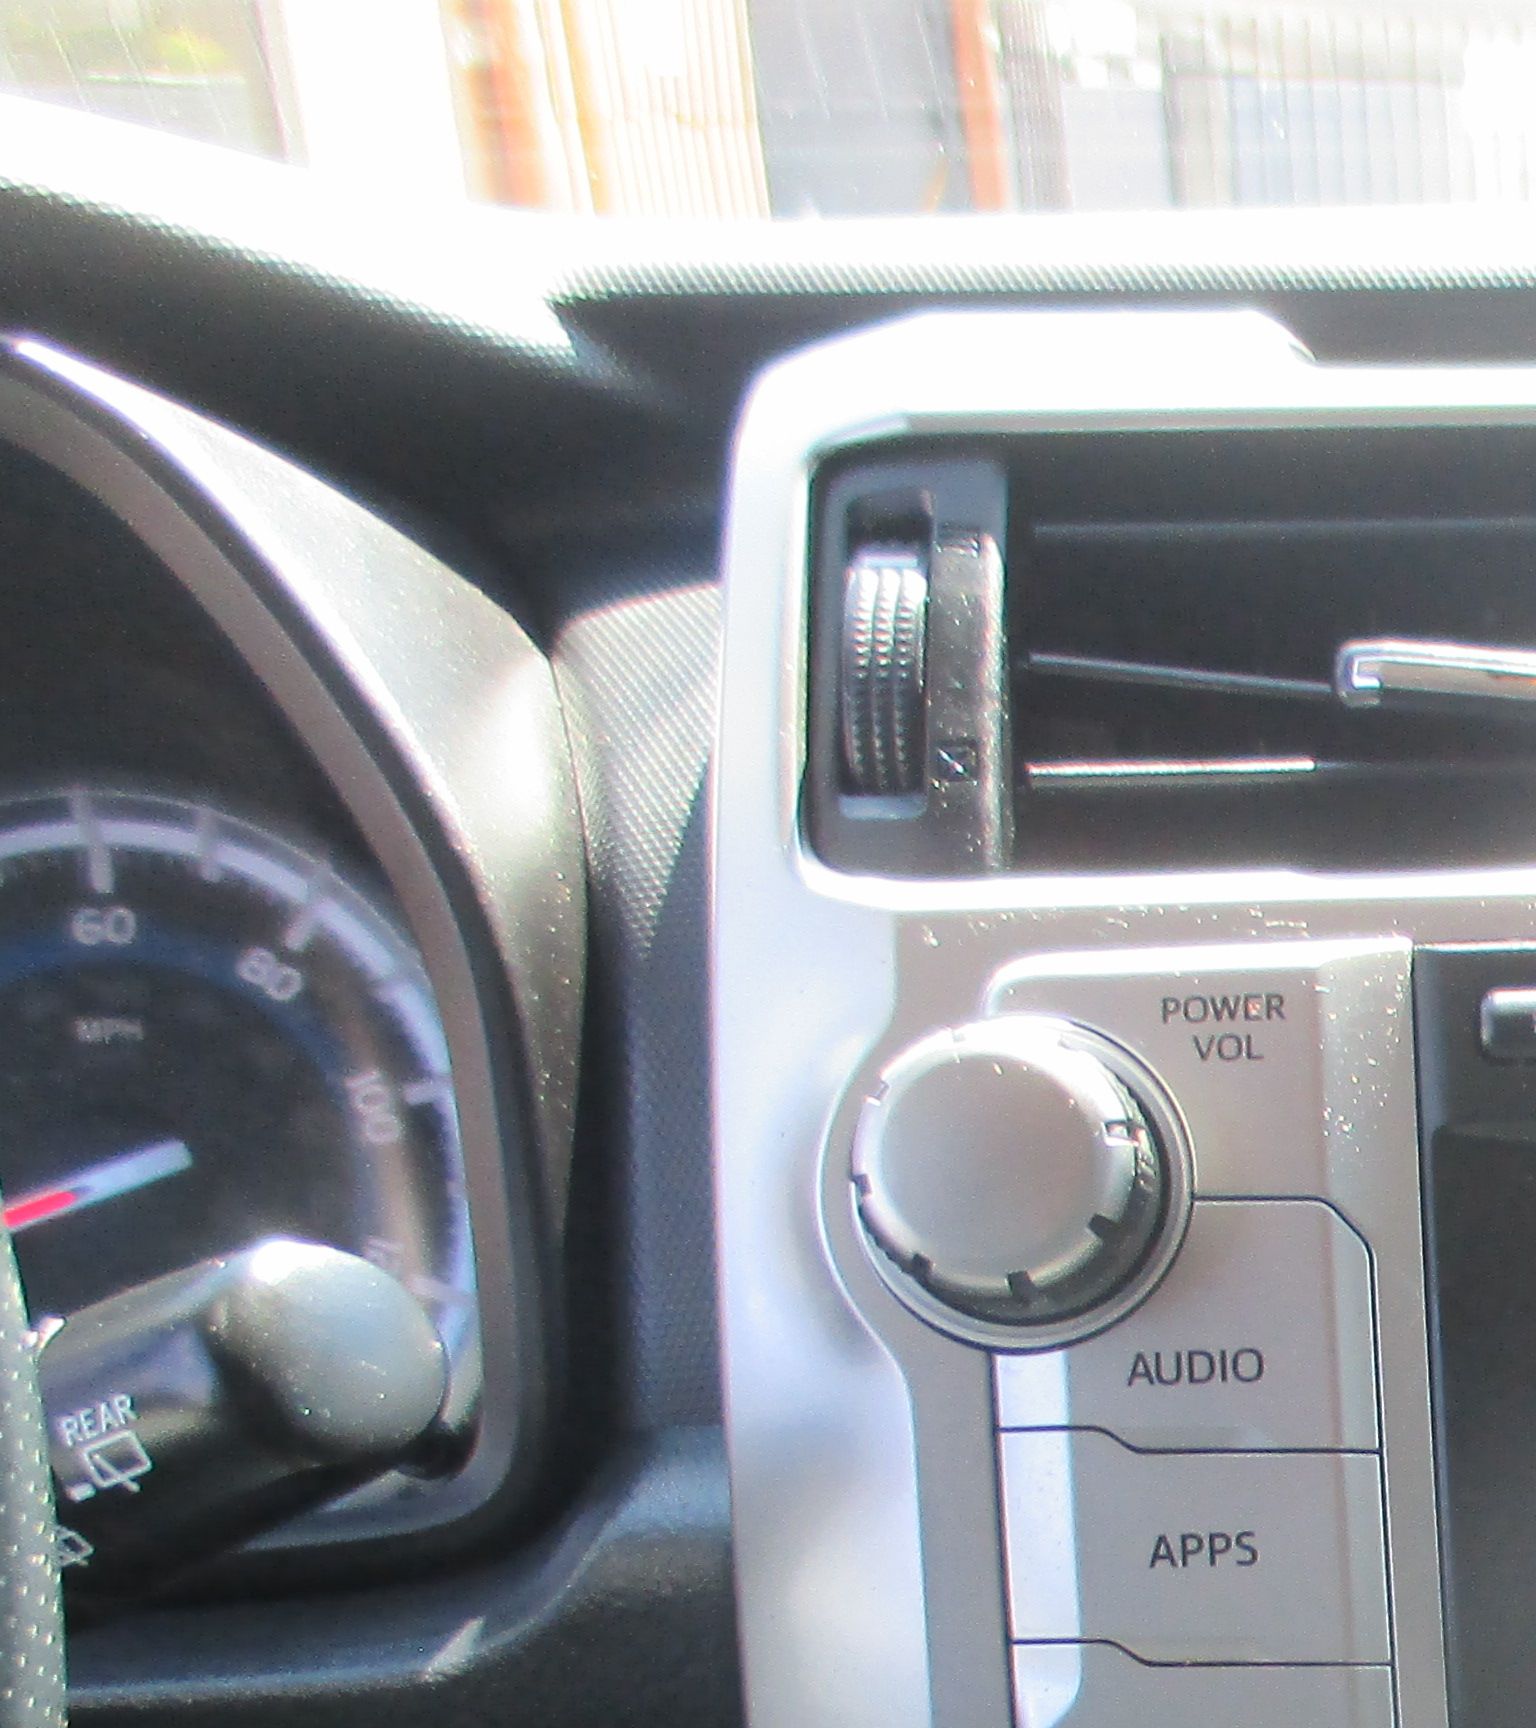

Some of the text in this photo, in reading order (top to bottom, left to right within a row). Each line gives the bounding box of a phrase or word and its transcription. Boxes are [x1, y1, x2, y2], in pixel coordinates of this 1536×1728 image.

[71, 906, 136, 945] 60
[237, 947, 301, 1002] 80
[1161, 994, 1286, 1024] POWER
[1193, 1033, 1264, 1062] VOL
[346, 1070, 401, 1144] 100
[1126, 1346, 1266, 1387] AUDIO
[60, 1393, 139, 1447] REAR
[1149, 1530, 1260, 1570] APPS
